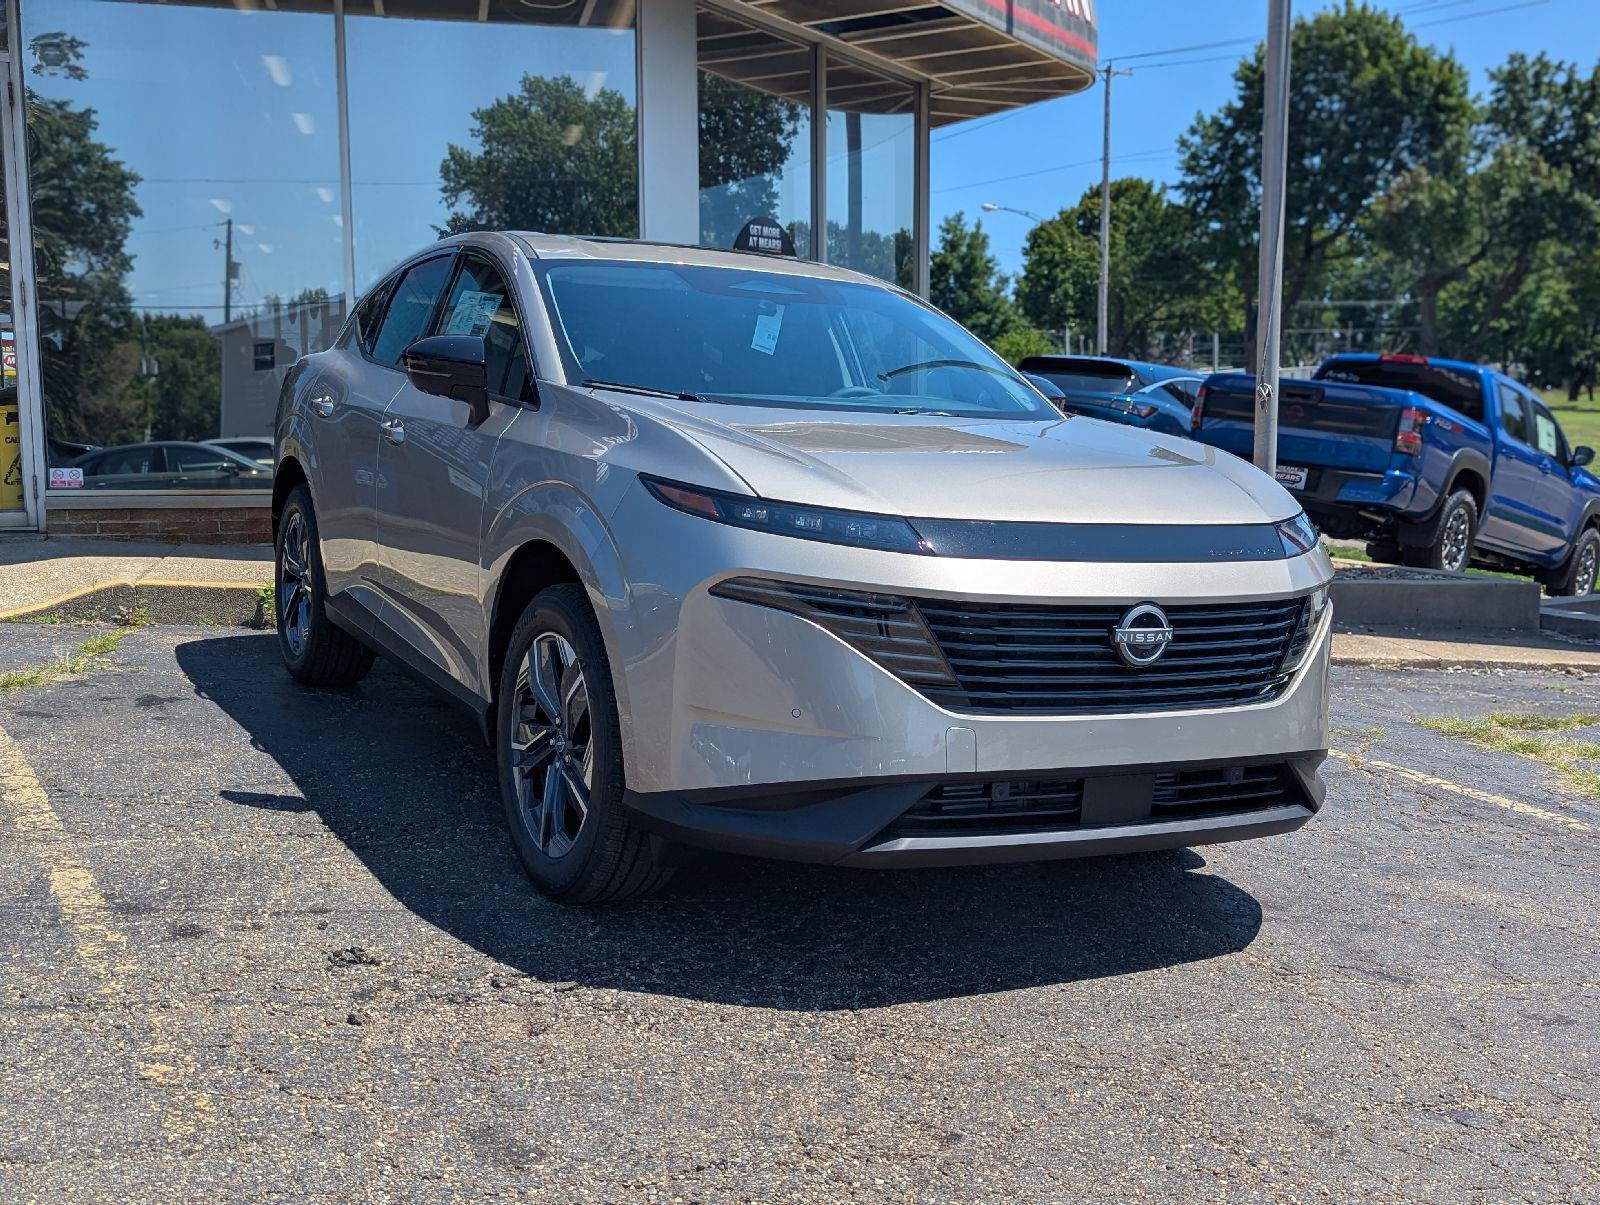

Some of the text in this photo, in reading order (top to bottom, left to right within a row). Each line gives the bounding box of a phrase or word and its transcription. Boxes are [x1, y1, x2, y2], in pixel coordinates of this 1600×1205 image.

[749, 225, 780, 238] GET MORE
[749, 237, 758, 247] AT
[1117, 631, 1173, 642] NISSAN
